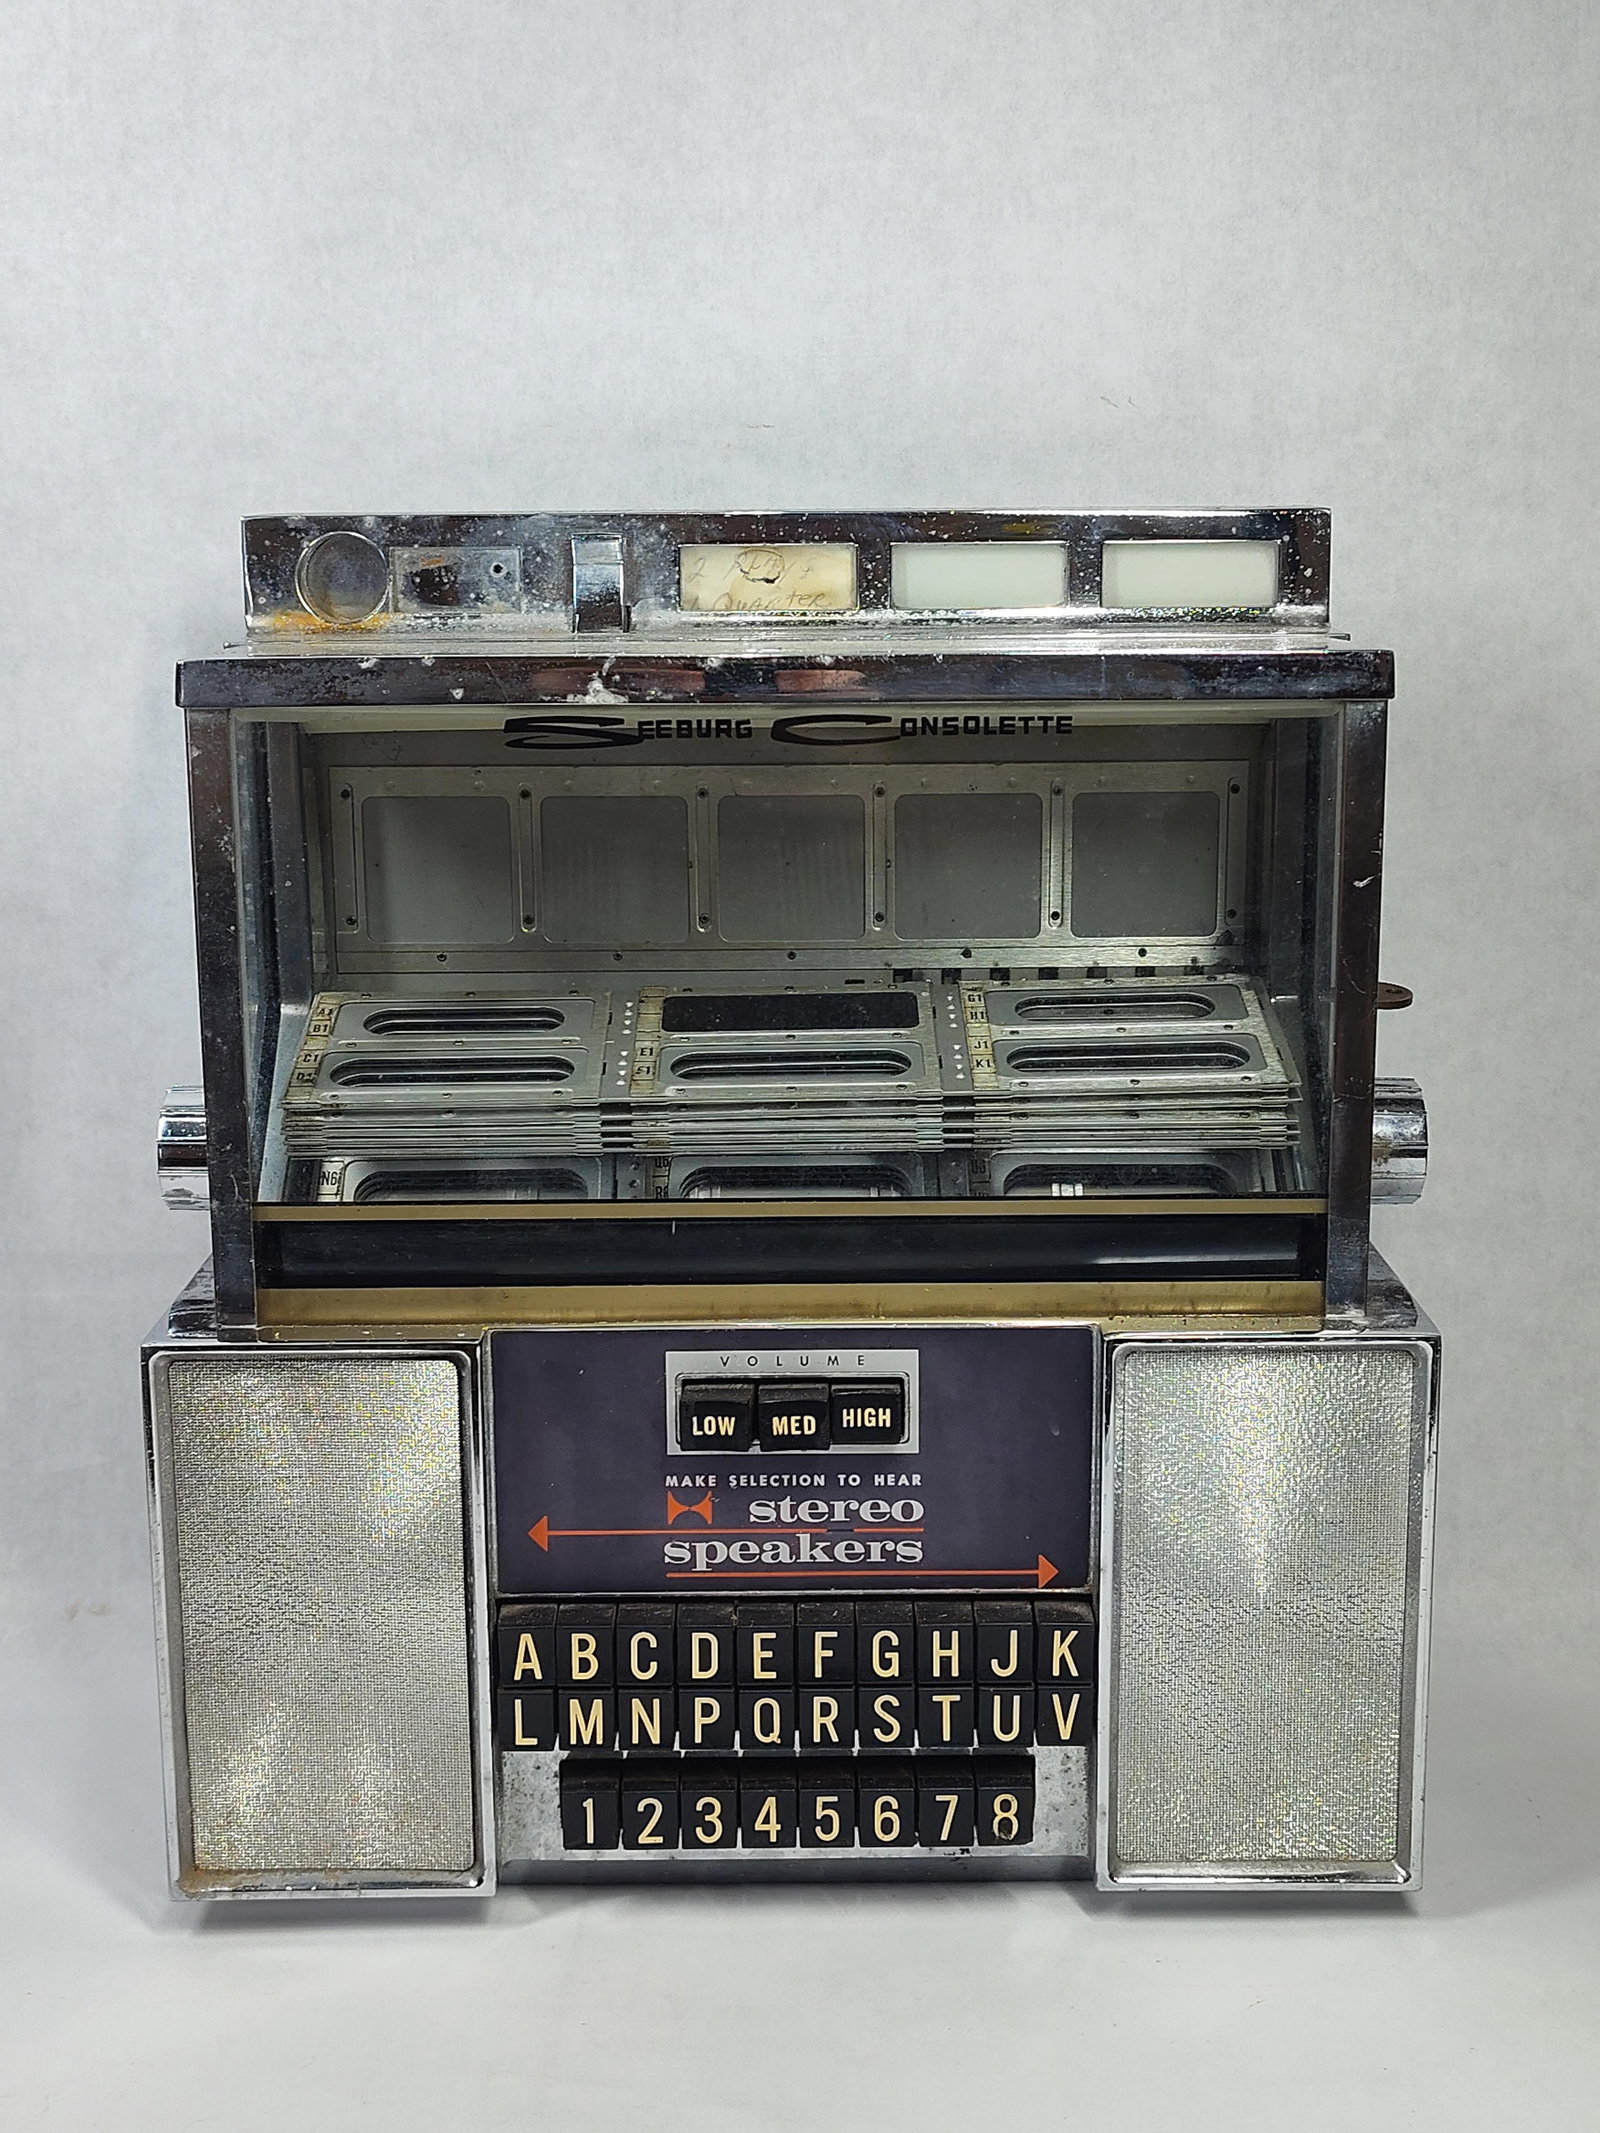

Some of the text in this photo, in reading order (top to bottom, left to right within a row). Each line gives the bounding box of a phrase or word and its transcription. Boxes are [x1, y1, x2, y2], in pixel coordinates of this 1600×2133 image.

[503, 714, 1074, 750] SEEBURG CONSOLETTE
[967, 994, 982, 1003] G1
[312, 1024, 329, 1033] B1
[639, 1047, 654, 1057] E1
[974, 1041, 989, 1050] J1
[303, 1053, 319, 1063] C1
[976, 1058, 992, 1068] K1
[719, 1355, 865, 1367] VOLUME
[692, 1407, 891, 1436] LOW MED HIGH
[665, 1473, 922, 1488] MAKE SELECTION TO HEAR
[749, 1495, 924, 1523] stereo
[663, 1532, 924, 1572] speakers
[514, 1630, 1078, 1680] A B C D E F G H J K
[515, 1694, 1080, 1745] L M N P Q R S T U V
[582, 1794, 1018, 1843] 1 2 3 4 5 6 7 8
